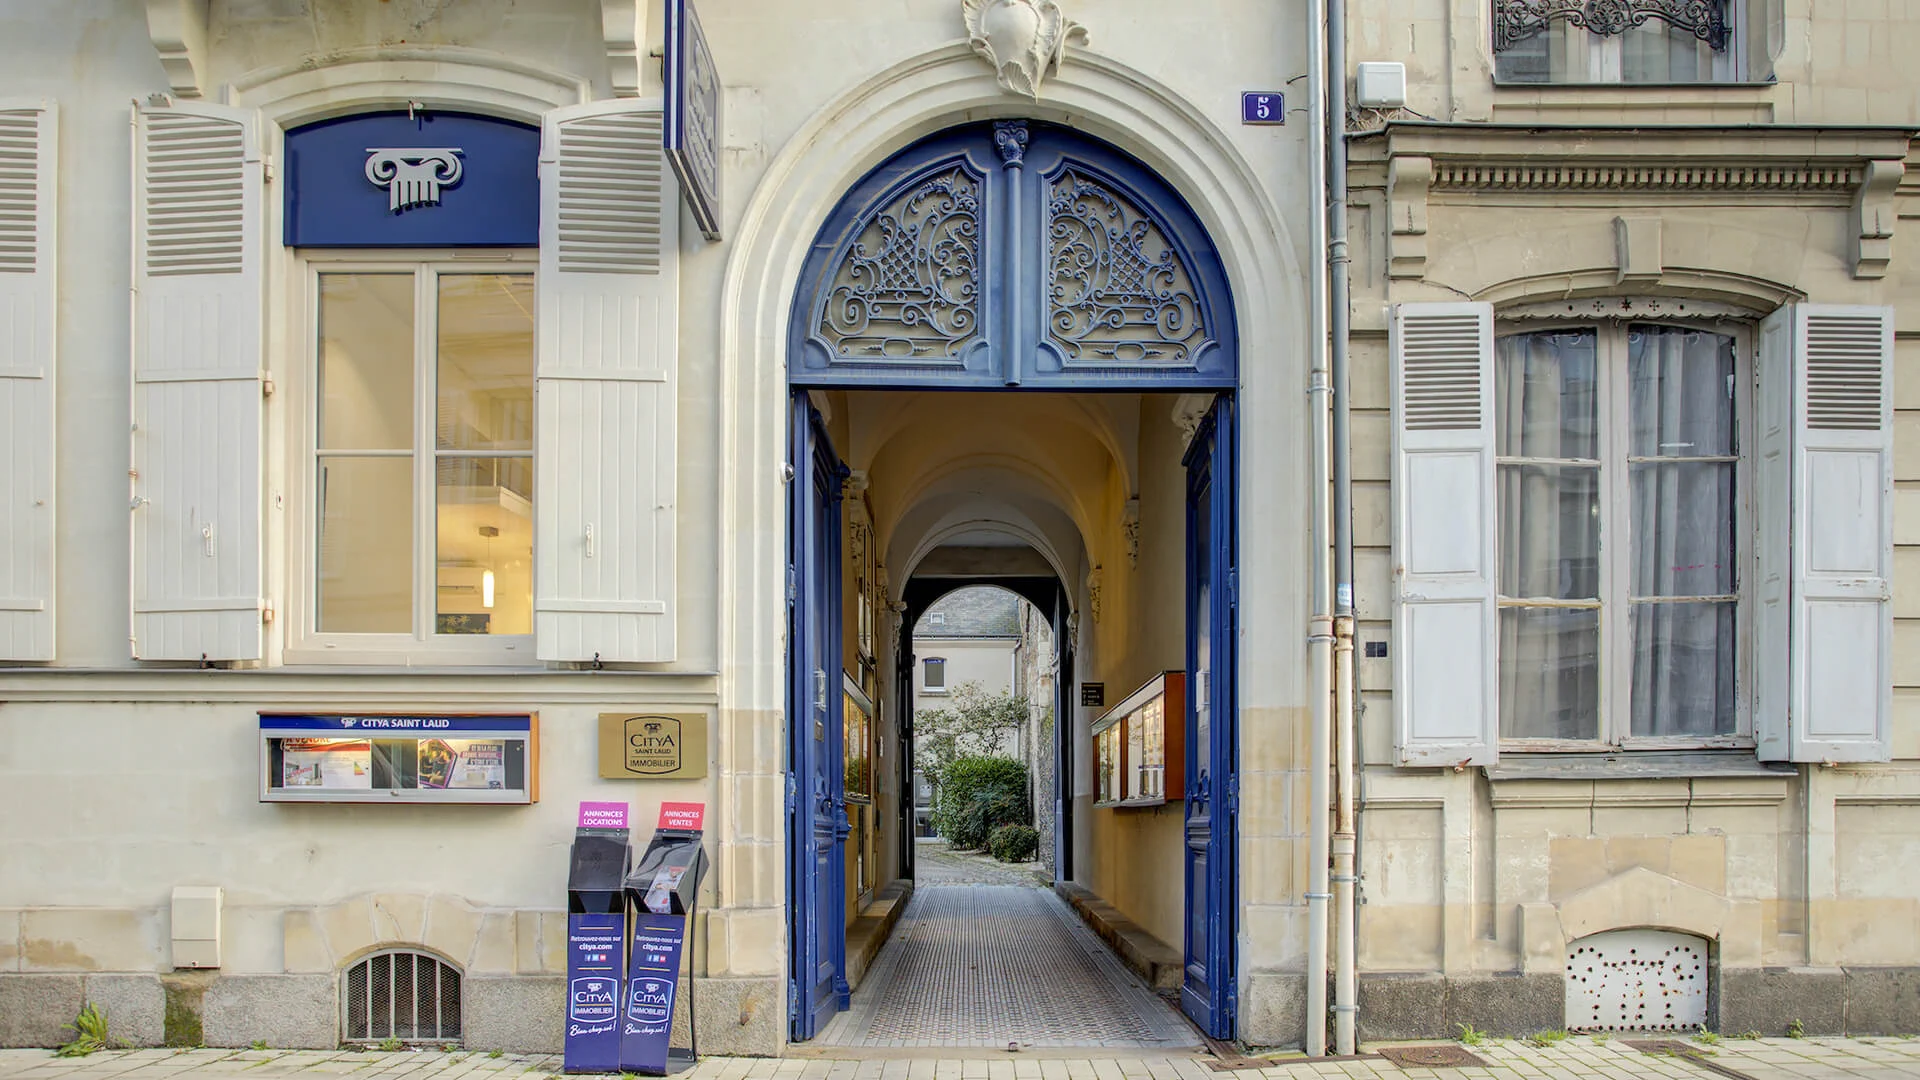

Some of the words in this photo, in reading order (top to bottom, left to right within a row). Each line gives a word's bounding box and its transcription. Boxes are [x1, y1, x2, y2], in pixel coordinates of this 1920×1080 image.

[1256, 96, 1270, 119] 5
[361, 718, 390, 728] CITYA
[391, 718, 420, 728] SAINT
[422, 718, 450, 728] LAUD
[630, 734, 675, 747] CITYA
[630, 759, 676, 767] IMMOBILIER
[583, 810, 624, 818] ANNONCES
[664, 810, 700, 819] ANNONCES
[583, 818, 623, 826] LOCATIONS
[668, 819, 693, 827] VENTES
[579, 942, 613, 951] citya.com
[642, 942, 673, 952] citya.com
[575, 991, 614, 1003] CITYA
[633, 991, 667, 1004] CITYA
[574, 1006, 613, 1015] IMMOBILIER
[631, 1006, 666, 1016] IMMOBILIER
